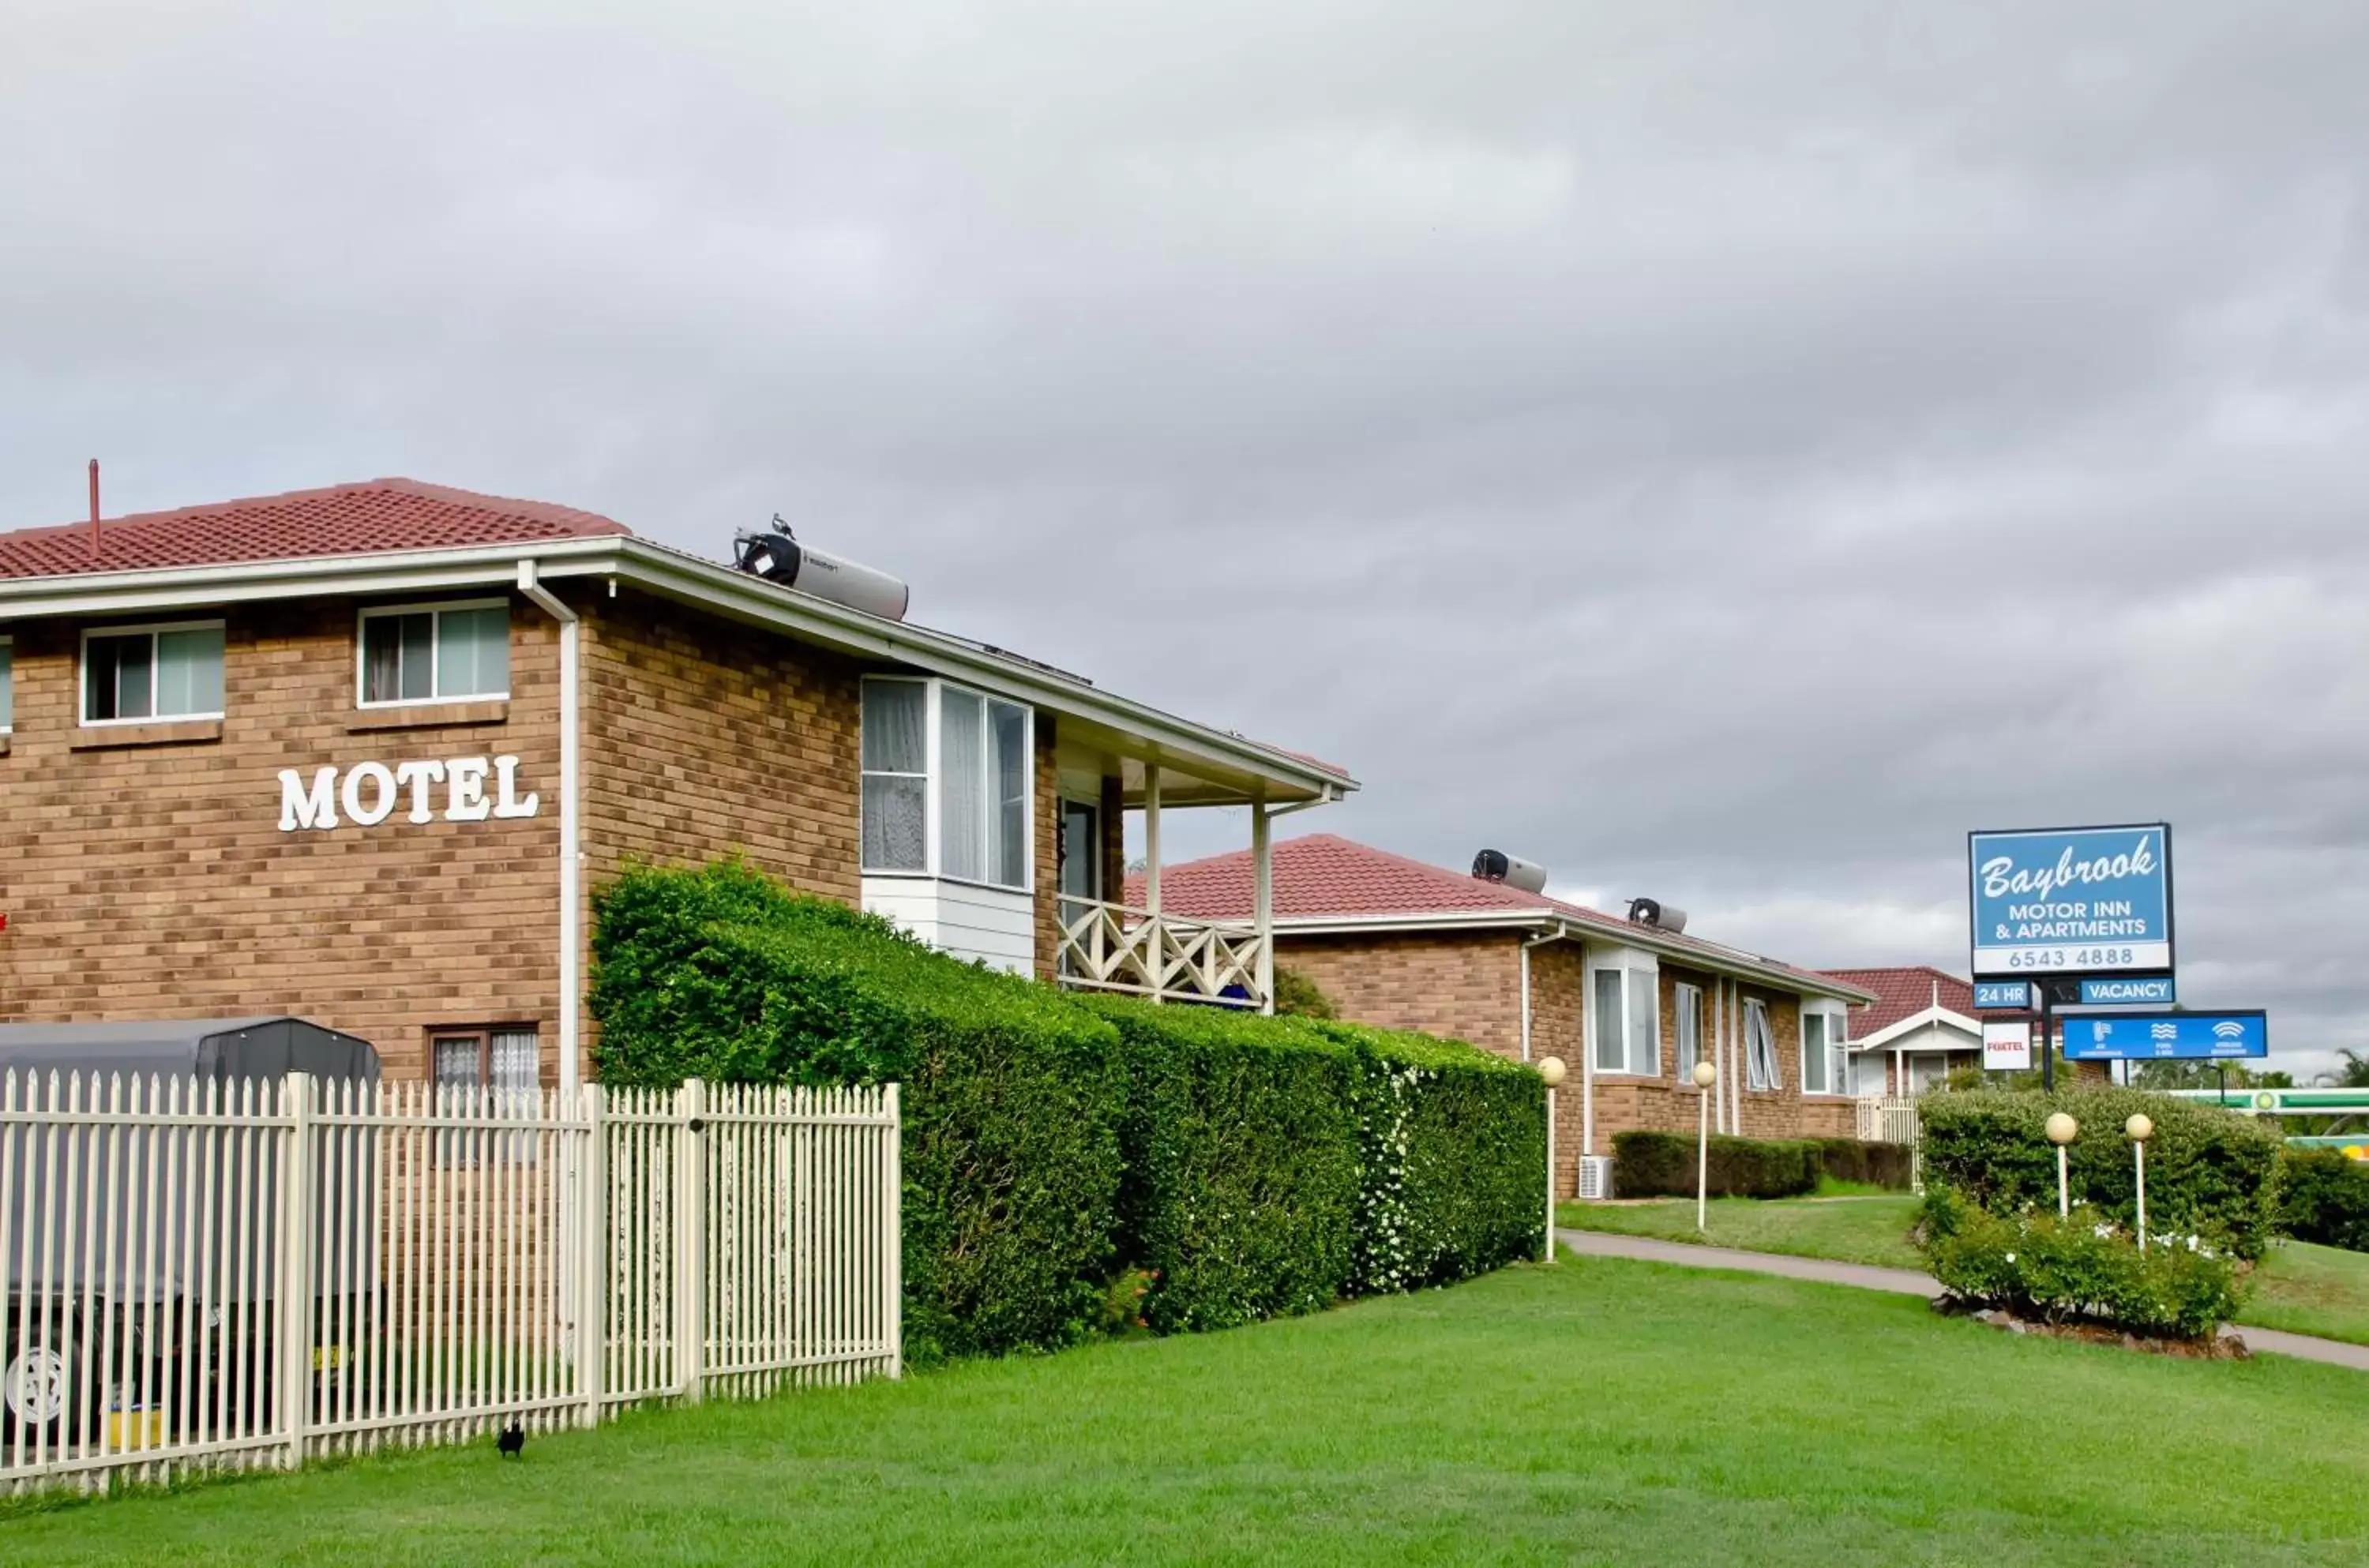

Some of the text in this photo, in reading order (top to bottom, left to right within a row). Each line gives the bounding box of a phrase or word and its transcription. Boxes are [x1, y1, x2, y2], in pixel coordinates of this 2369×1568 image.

[278, 755, 539, 831] MOTEL
[1980, 834, 2158, 902] Baybrook
[2009, 900, 2131, 921] MOTOR INN
[1995, 918, 2146, 940] & APARTMENTS
[2009, 948, 2133, 967] 6543 4888
[1978, 987, 2025, 1003] 24 HR
[2089, 982, 2168, 999] VACANCY
